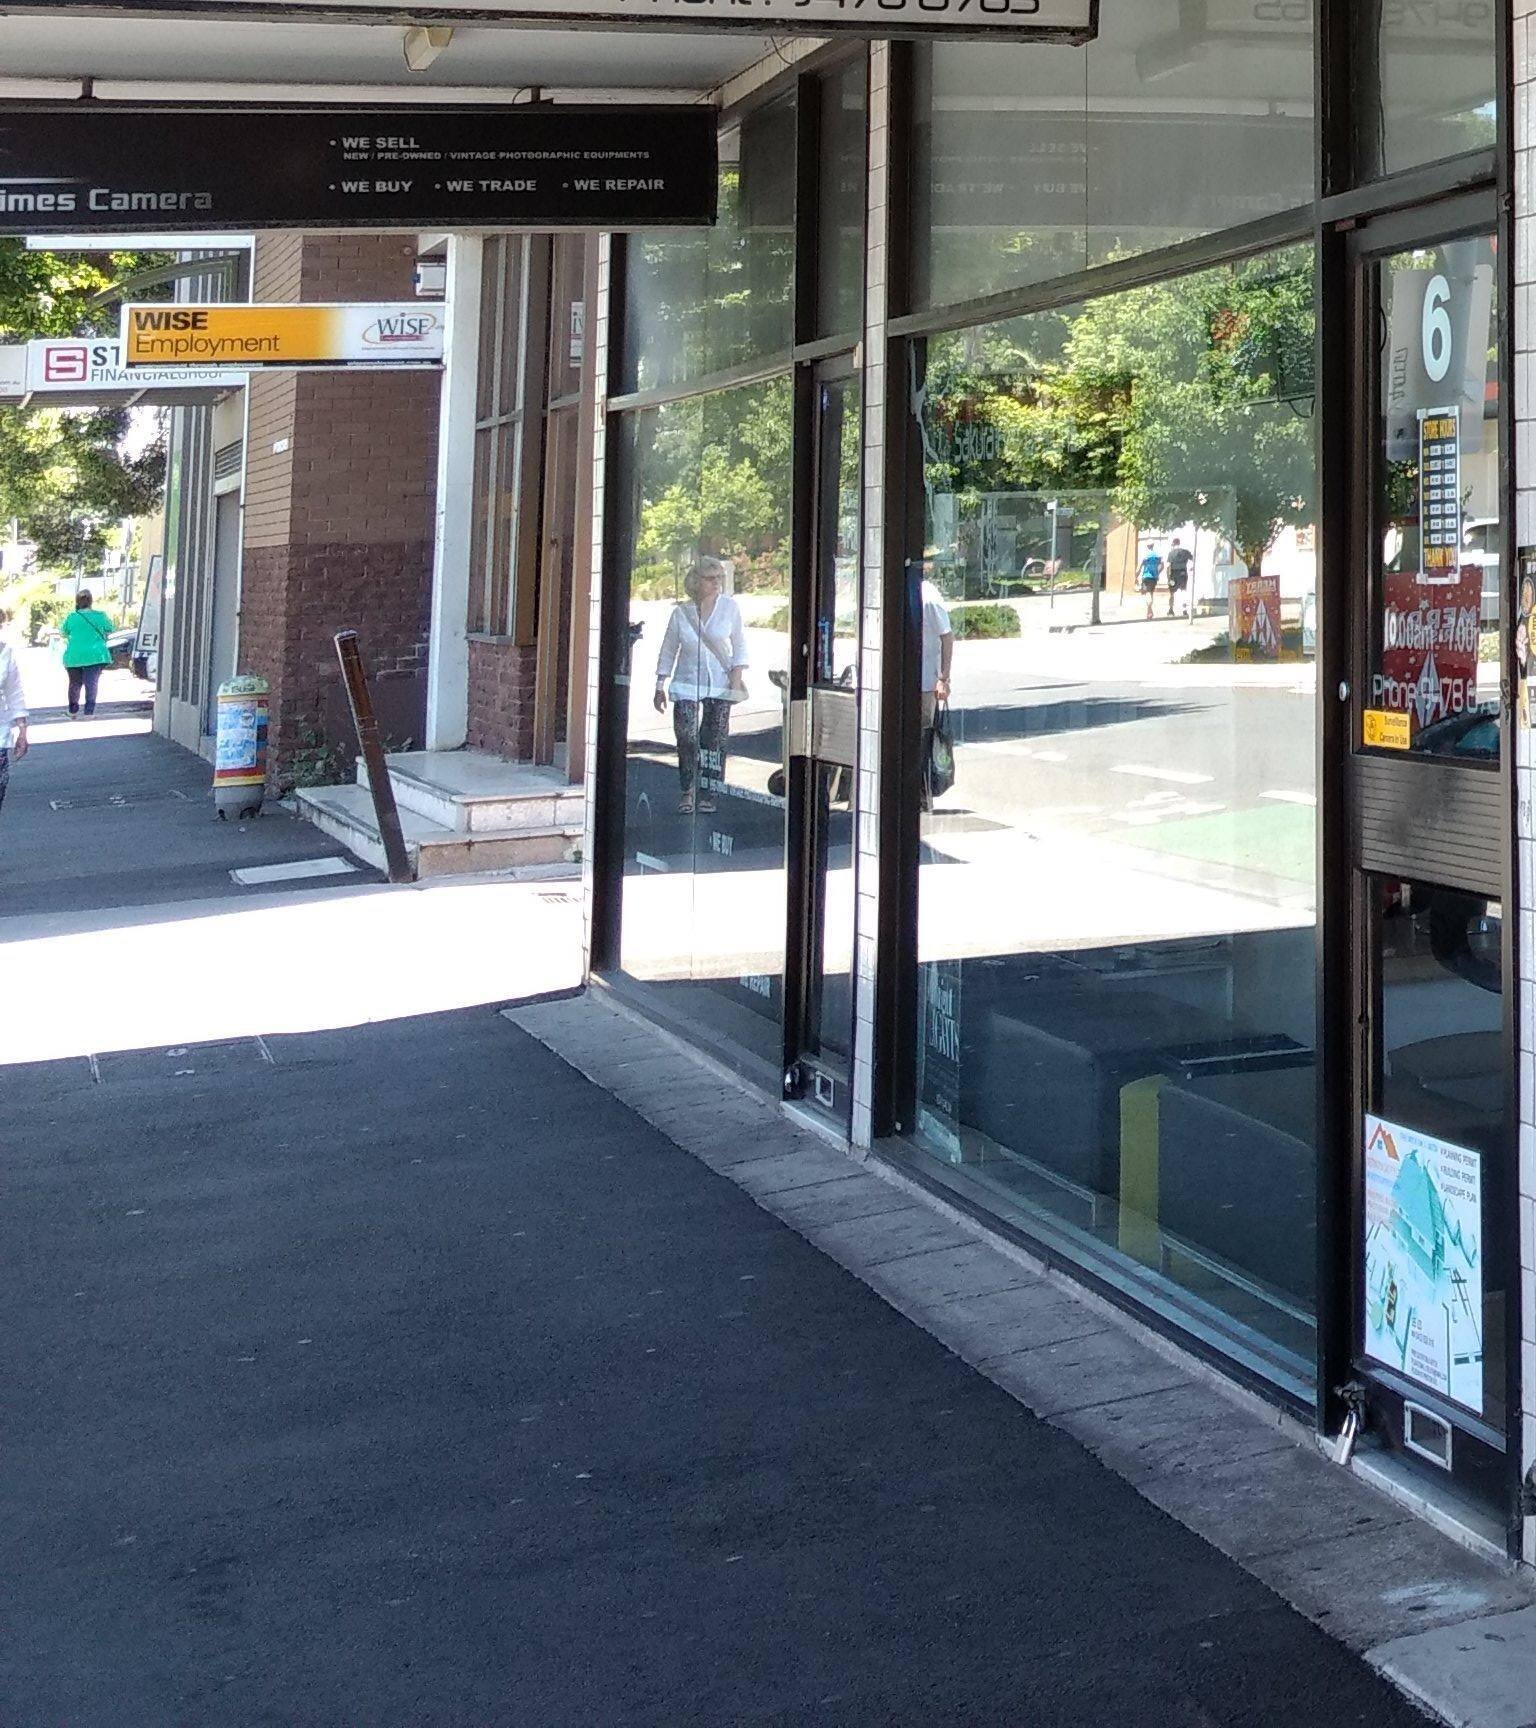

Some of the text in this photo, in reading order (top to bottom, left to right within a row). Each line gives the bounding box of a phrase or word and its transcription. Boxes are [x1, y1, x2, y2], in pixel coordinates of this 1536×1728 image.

[342, 137, 420, 149] WE SELL
[343, 152, 368, 161] NEW
[583, 151, 650, 160] EQUIPMENTS
[341, 180, 413, 193] WE BUY
[446, 180, 537, 191] WE TRADE
[573, 178, 665, 191] WE REPAIR
[89, 187, 213, 212] Camera
[134, 311, 208, 332] WISE
[1421, 274, 1452, 382] 6
[135, 333, 281, 357] Employment
